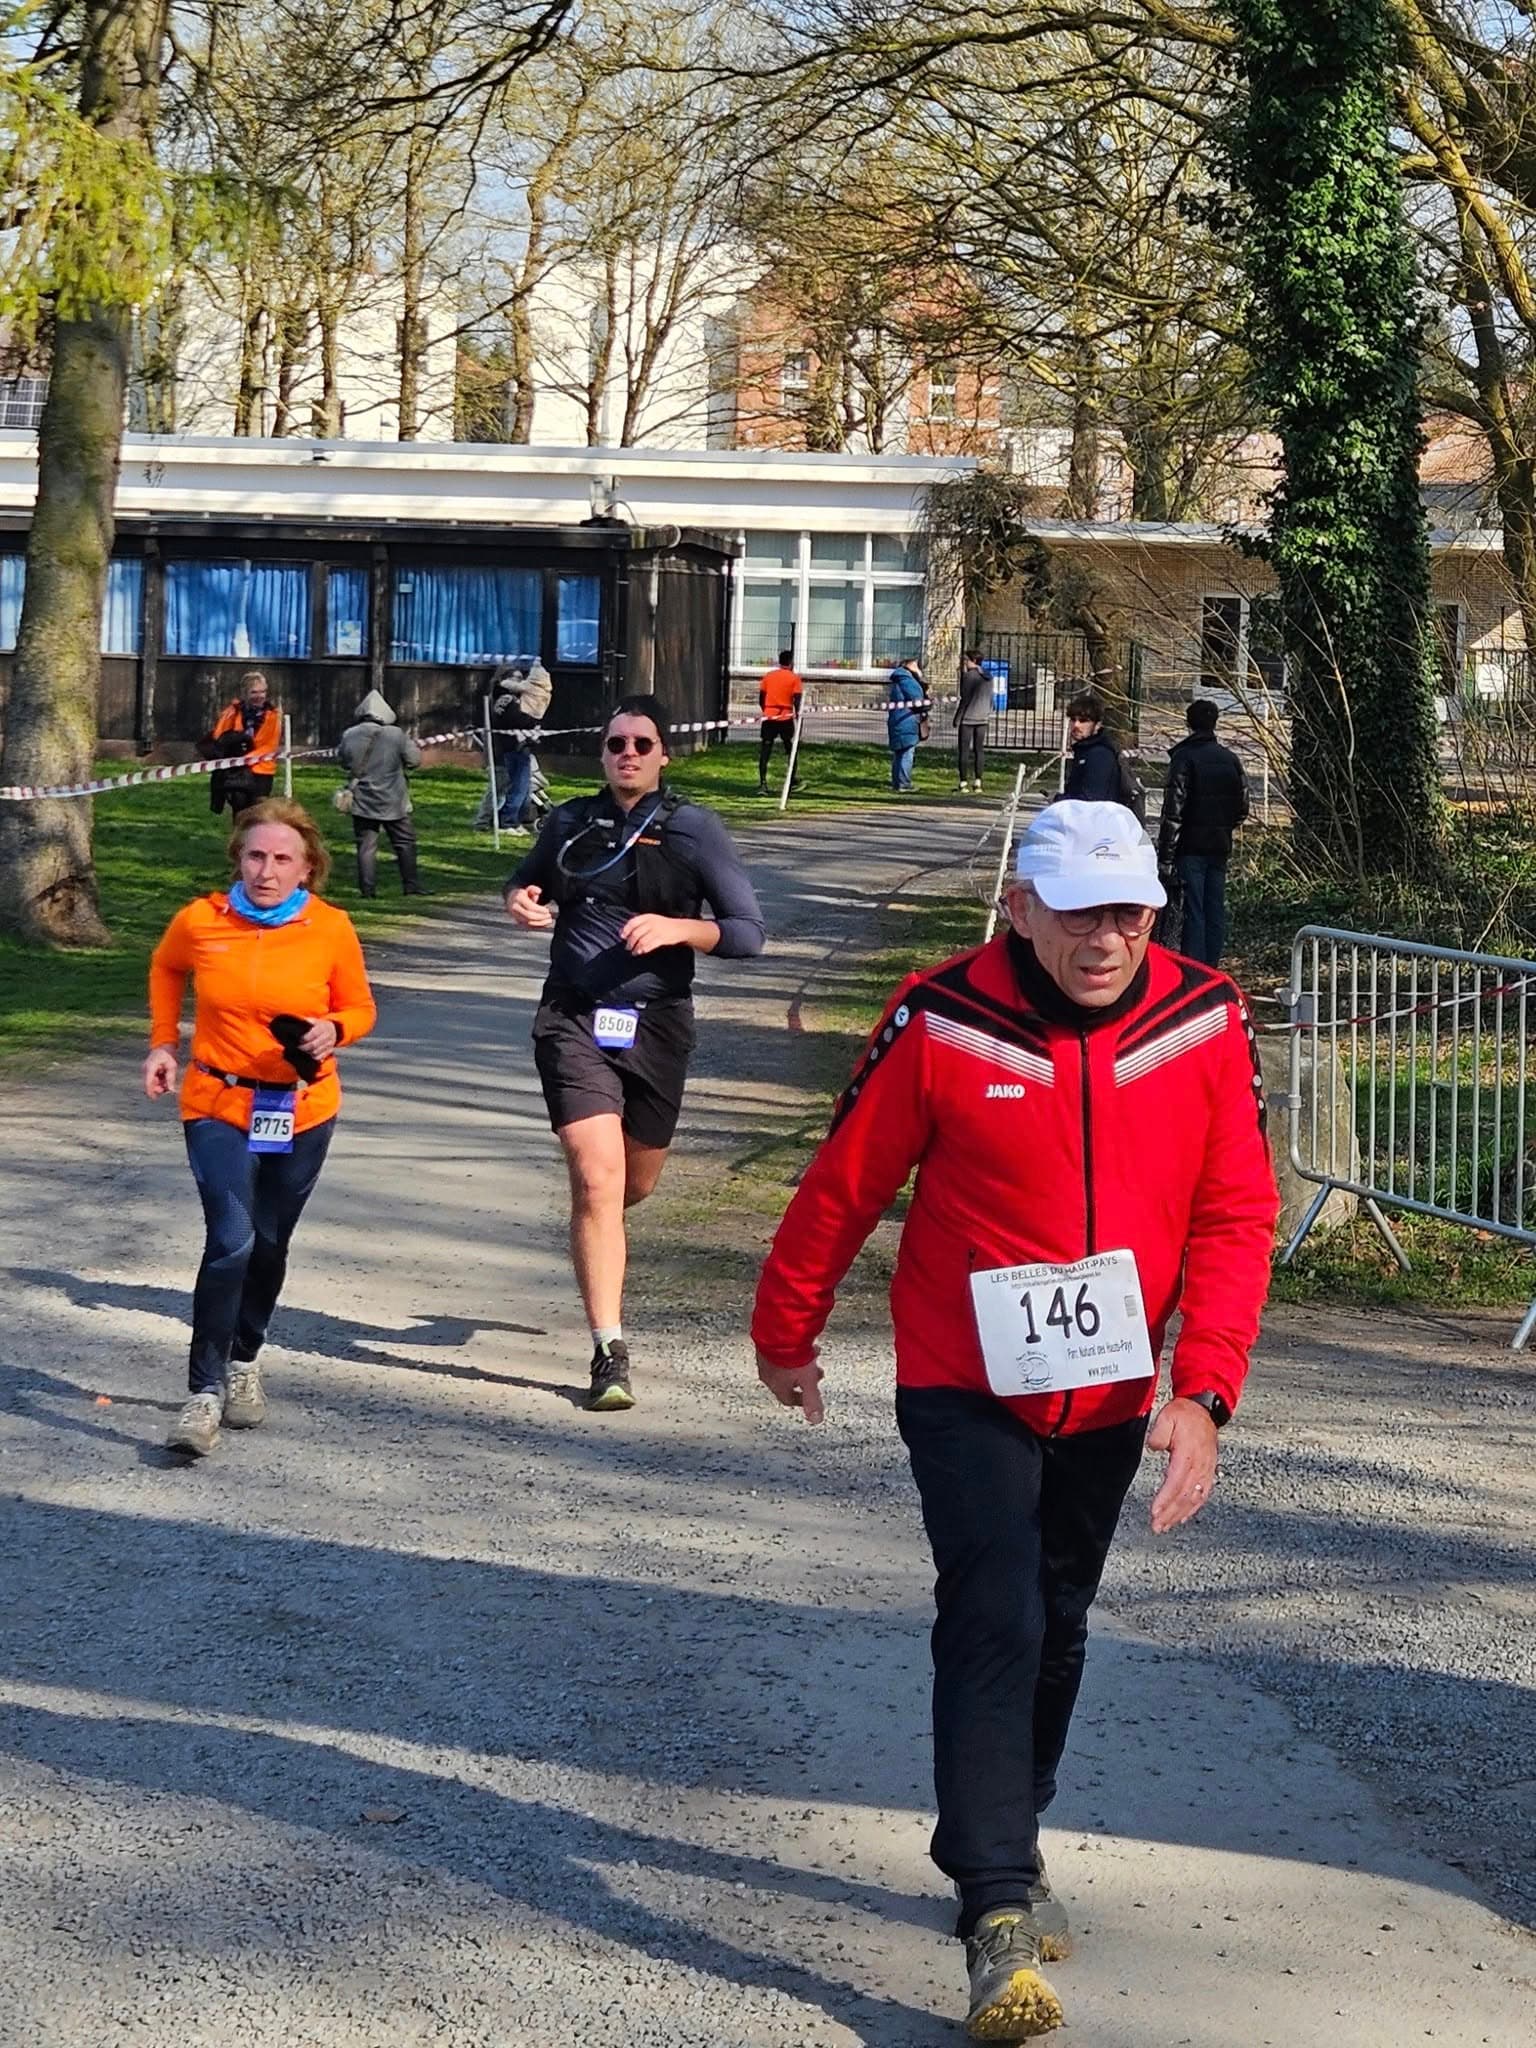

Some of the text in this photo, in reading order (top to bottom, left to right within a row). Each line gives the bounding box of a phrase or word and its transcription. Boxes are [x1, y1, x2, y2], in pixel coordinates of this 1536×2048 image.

[598, 1015, 634, 1033] 8508
[985, 1083, 1026, 1099] JAKO
[253, 1116, 291, 1136] 8775
[990, 1272, 1009, 1284] LES
[1011, 1266, 1048, 1281] BELLES
[1050, 1265, 1063, 1275] DU
[1019, 1282, 1101, 1345] 146
